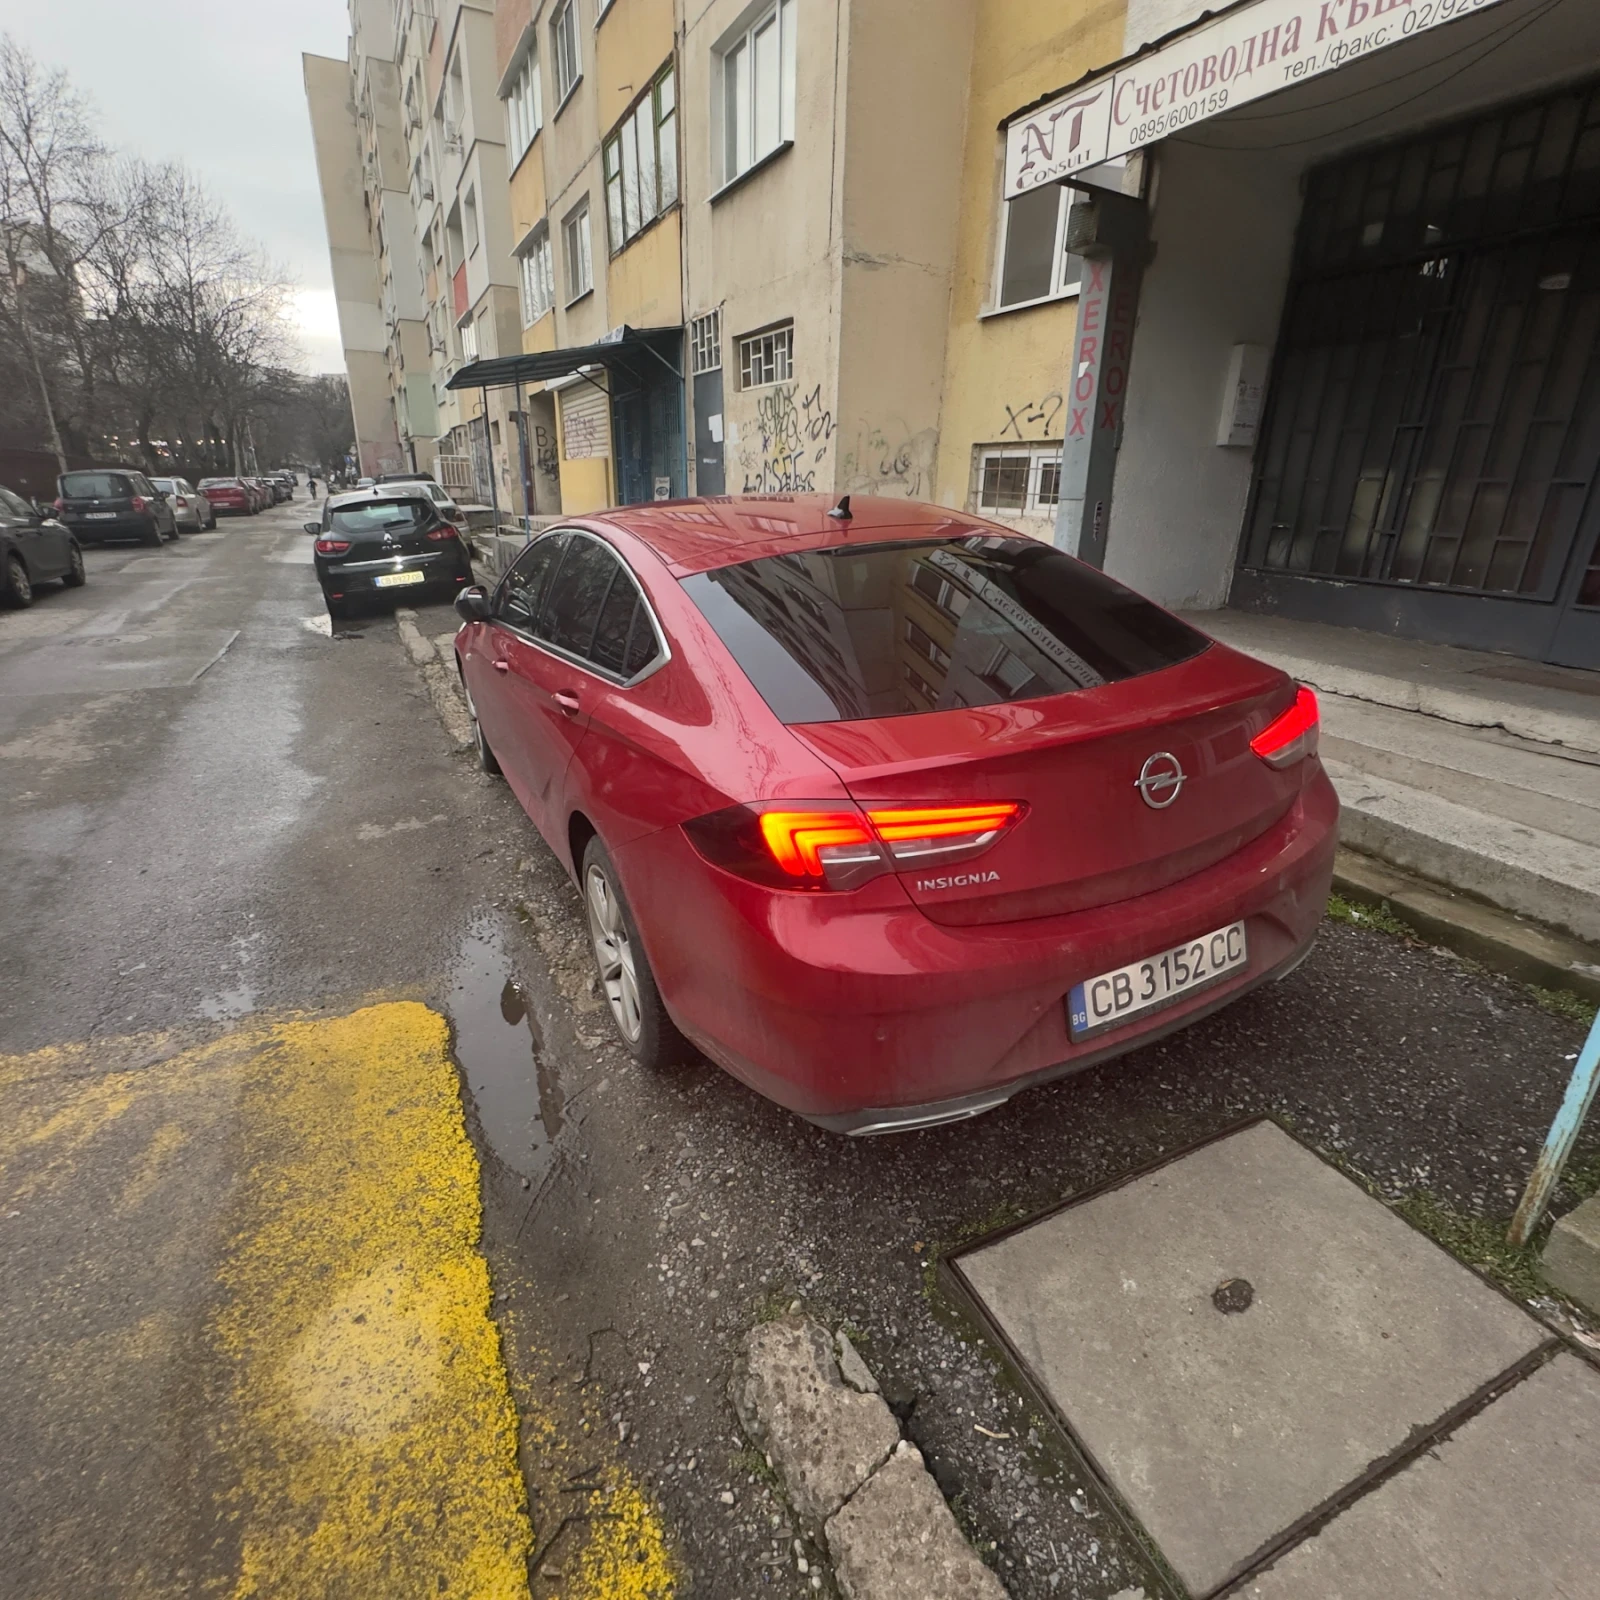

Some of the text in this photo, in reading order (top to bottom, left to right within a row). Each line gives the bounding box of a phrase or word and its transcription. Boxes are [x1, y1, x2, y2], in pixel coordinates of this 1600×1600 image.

[1113, 15, 1302, 126] Счетоводна
[1284, 24, 1394, 80] тел./факс:
[1129, 88, 1229, 144] 0895/600159
[1069, 260, 1106, 436] XEROX
[917, 870, 1000, 892] INSIGNIA
[1091, 926, 1242, 1018] CB 3152 CC
[1072, 1011, 1086, 1026] BG
